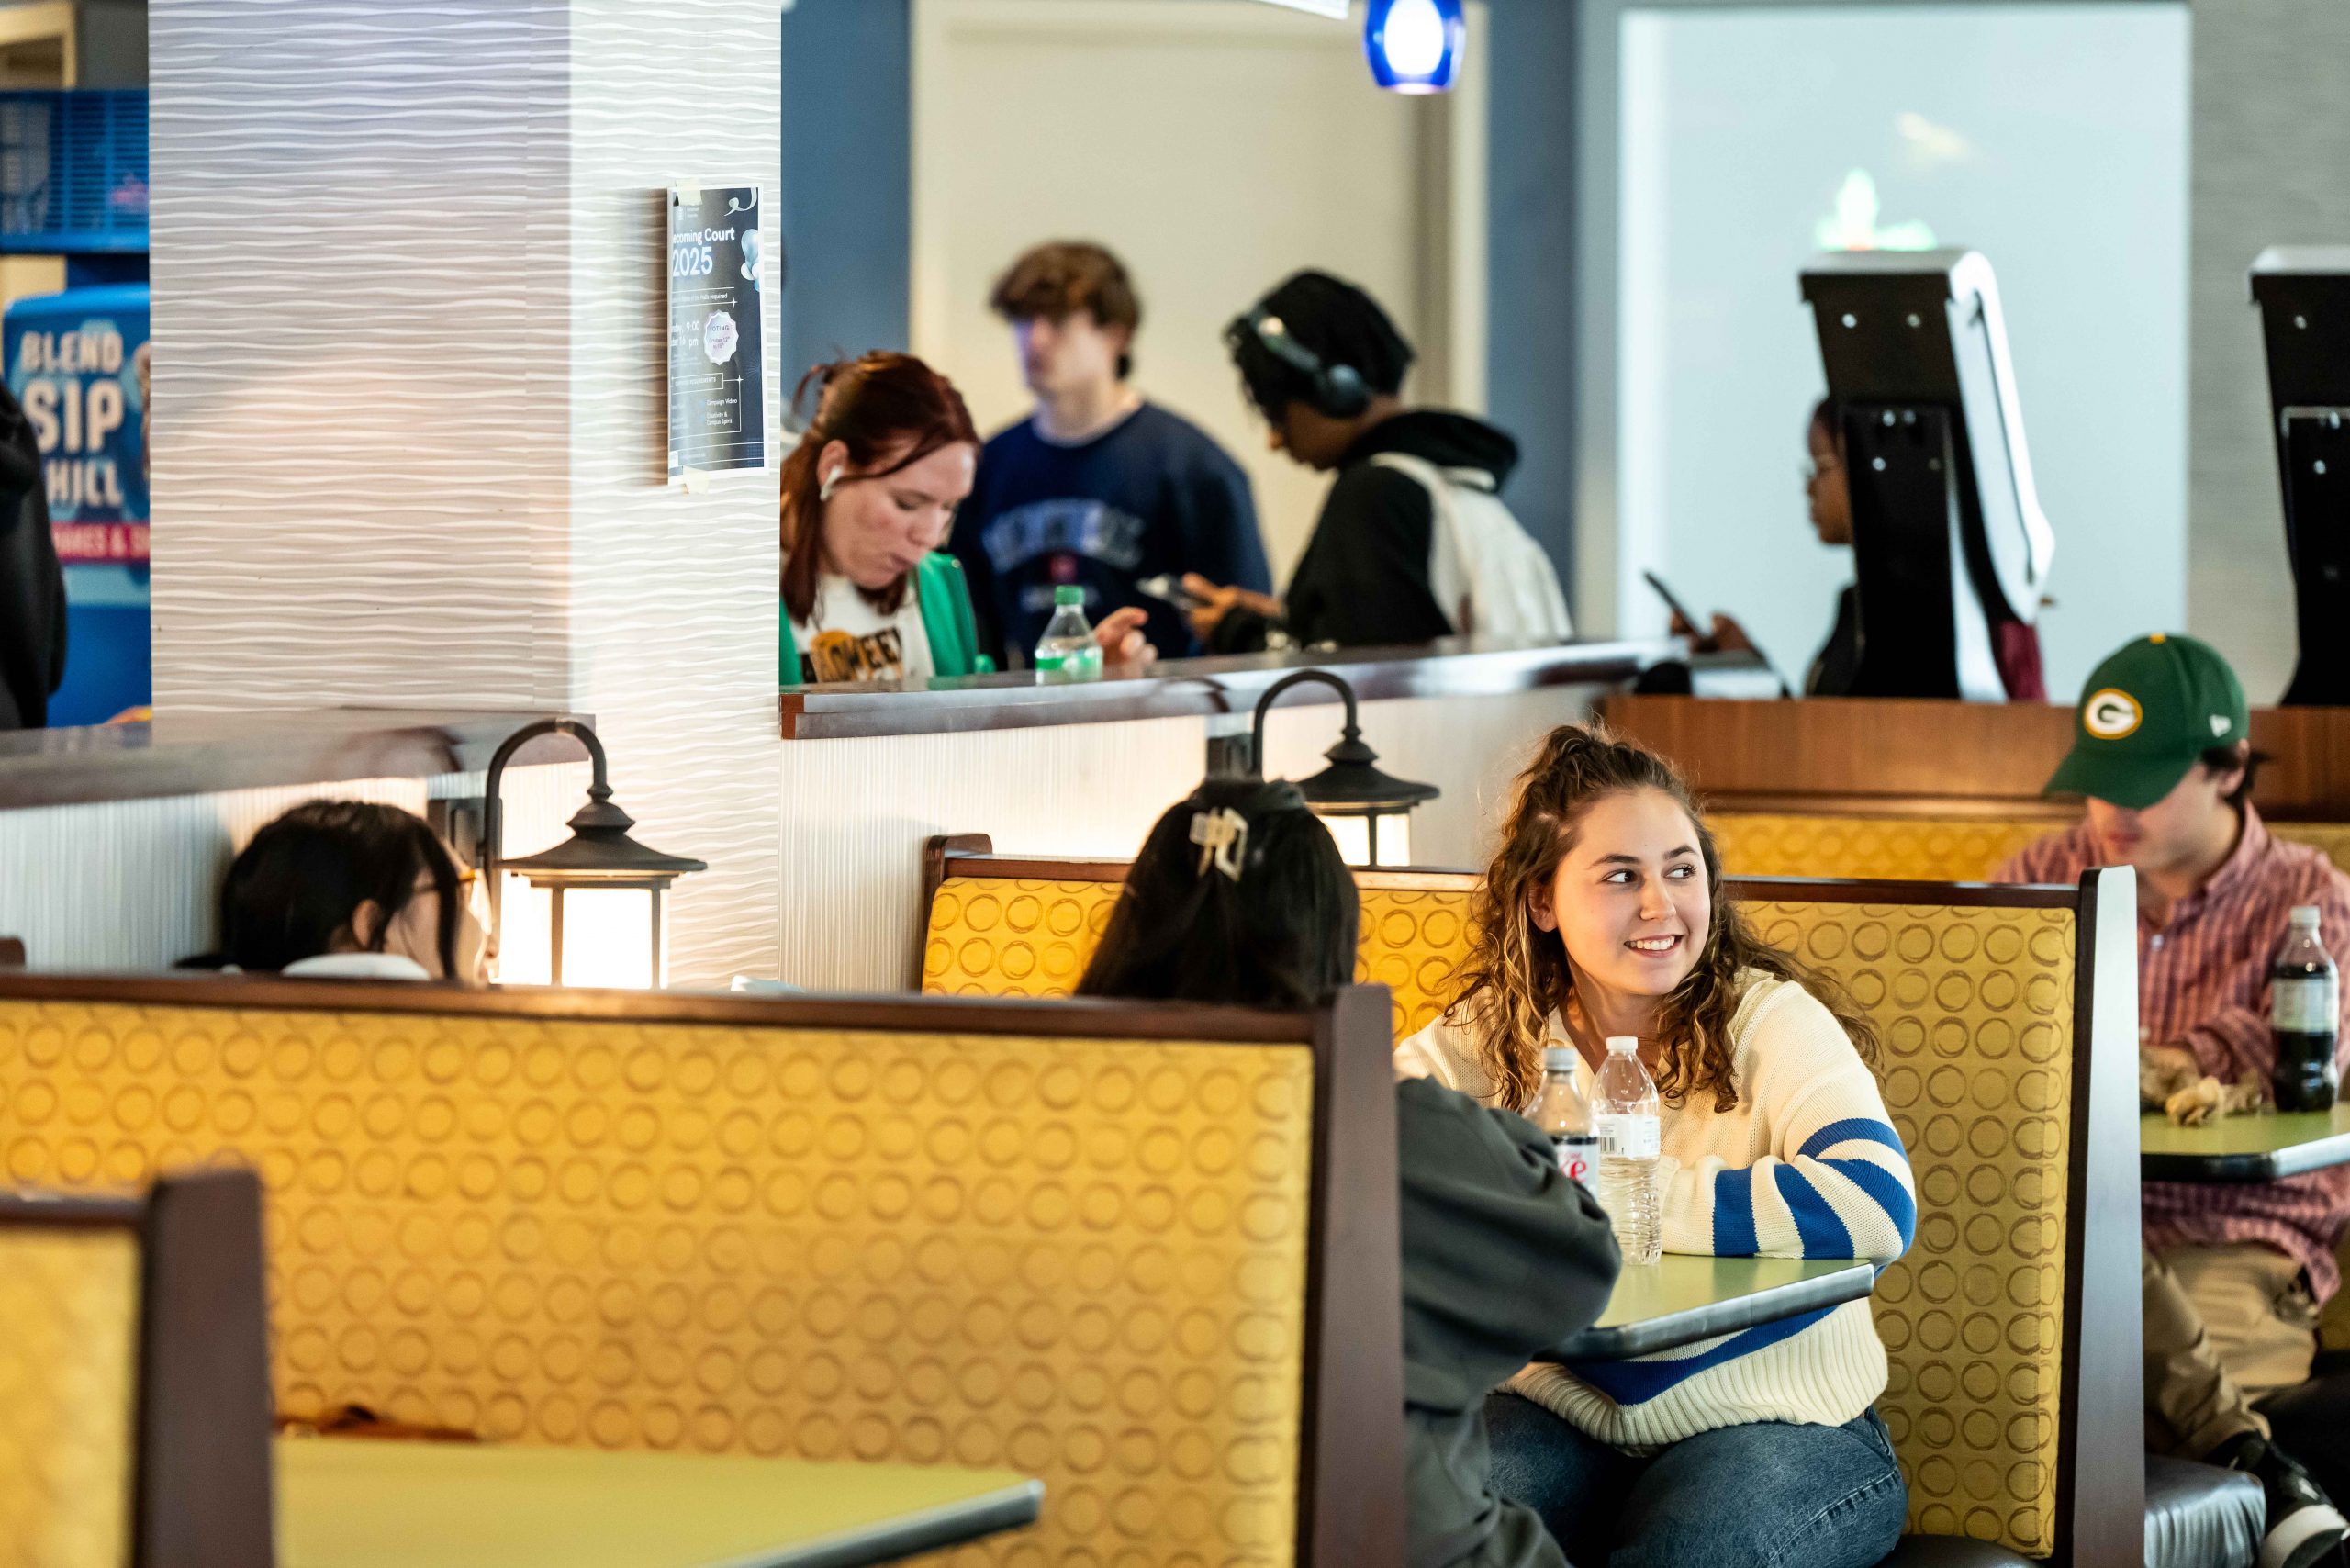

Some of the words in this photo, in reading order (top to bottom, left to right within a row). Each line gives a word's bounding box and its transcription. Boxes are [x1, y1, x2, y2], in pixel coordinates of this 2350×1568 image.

[704, 227, 735, 241] Court
[672, 246, 713, 276] 2025
[686, 320, 700, 331] 9:00
[20, 331, 122, 373] BLEND
[24, 378, 123, 454] SIP
[721, 418, 733, 426] Spirit
[47, 459, 122, 506] HILL
